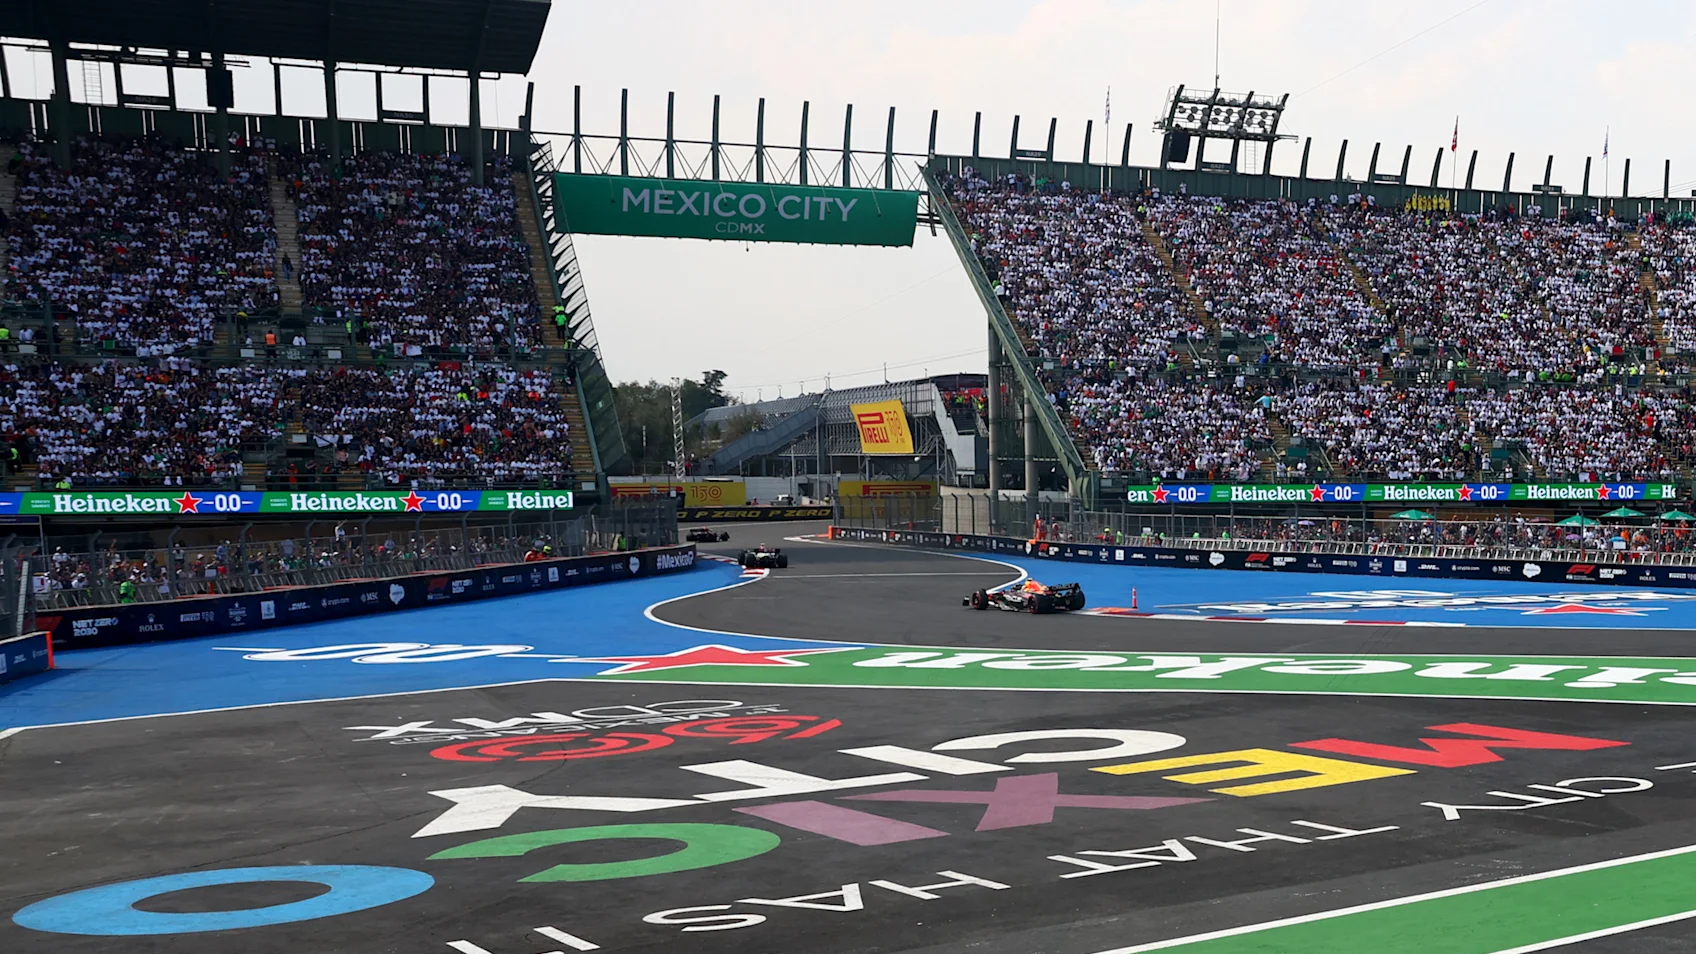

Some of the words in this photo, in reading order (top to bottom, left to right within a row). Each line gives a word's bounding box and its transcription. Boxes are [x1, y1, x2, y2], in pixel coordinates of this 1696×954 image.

[622, 187, 766, 218] MEXICO
[778, 194, 859, 222] CITY
[714, 221, 766, 235] CDMX
[857, 412, 890, 444] PIRELLI
[290, 493, 398, 511] Heineken
[437, 493, 462, 511] 0.0
[1178, 486, 1197, 502] 0.0
[1230, 486, 1306, 501] Heineken
[1333, 486, 1351, 501] 0.0
[1383, 486, 1454, 501] Heineken
[1480, 485, 1497, 500] 0.0
[1527, 485, 1594, 500] Heineken
[1618, 485, 1634, 499] 0.0
[53, 494, 171, 513] Heineken
[215, 493, 241, 512] 0.0
[709, 510, 761, 518] ZERO
[784, 509, 832, 517] ZERO
[139, 623, 164, 632] ROLEX
[341, 699, 744, 738] CDMX
[411, 728, 1187, 838] CITY
[1420, 775, 1655, 820] CITY
[12, 722, 1632, 936] MEXICO
[1047, 818, 1400, 880] THAT
[640, 870, 1012, 932] HAS
